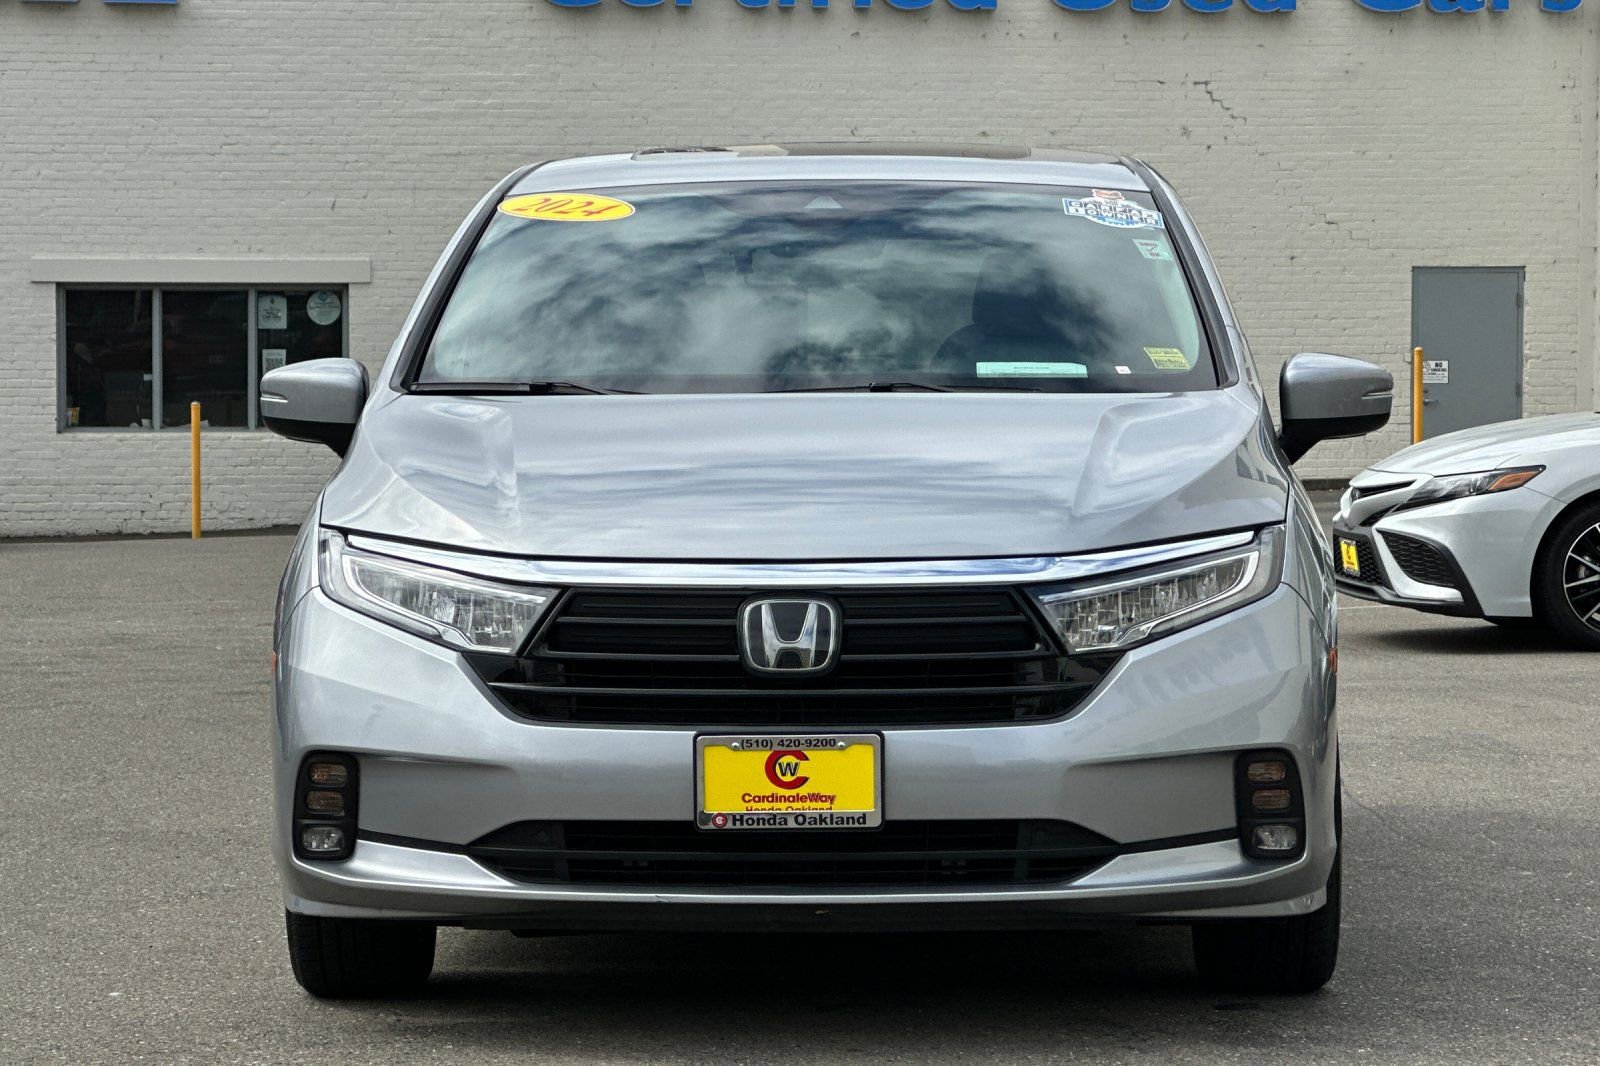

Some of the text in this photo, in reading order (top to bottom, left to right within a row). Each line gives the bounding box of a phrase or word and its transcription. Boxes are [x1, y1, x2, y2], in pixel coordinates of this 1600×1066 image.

[512, 198, 623, 216] 2024
[1086, 208, 1157, 225] OWNER
[741, 737, 837, 750] (510) 420-9200
[741, 792, 837, 805] CardinaleWay
[732, 812, 867, 827] Honda Oakland
